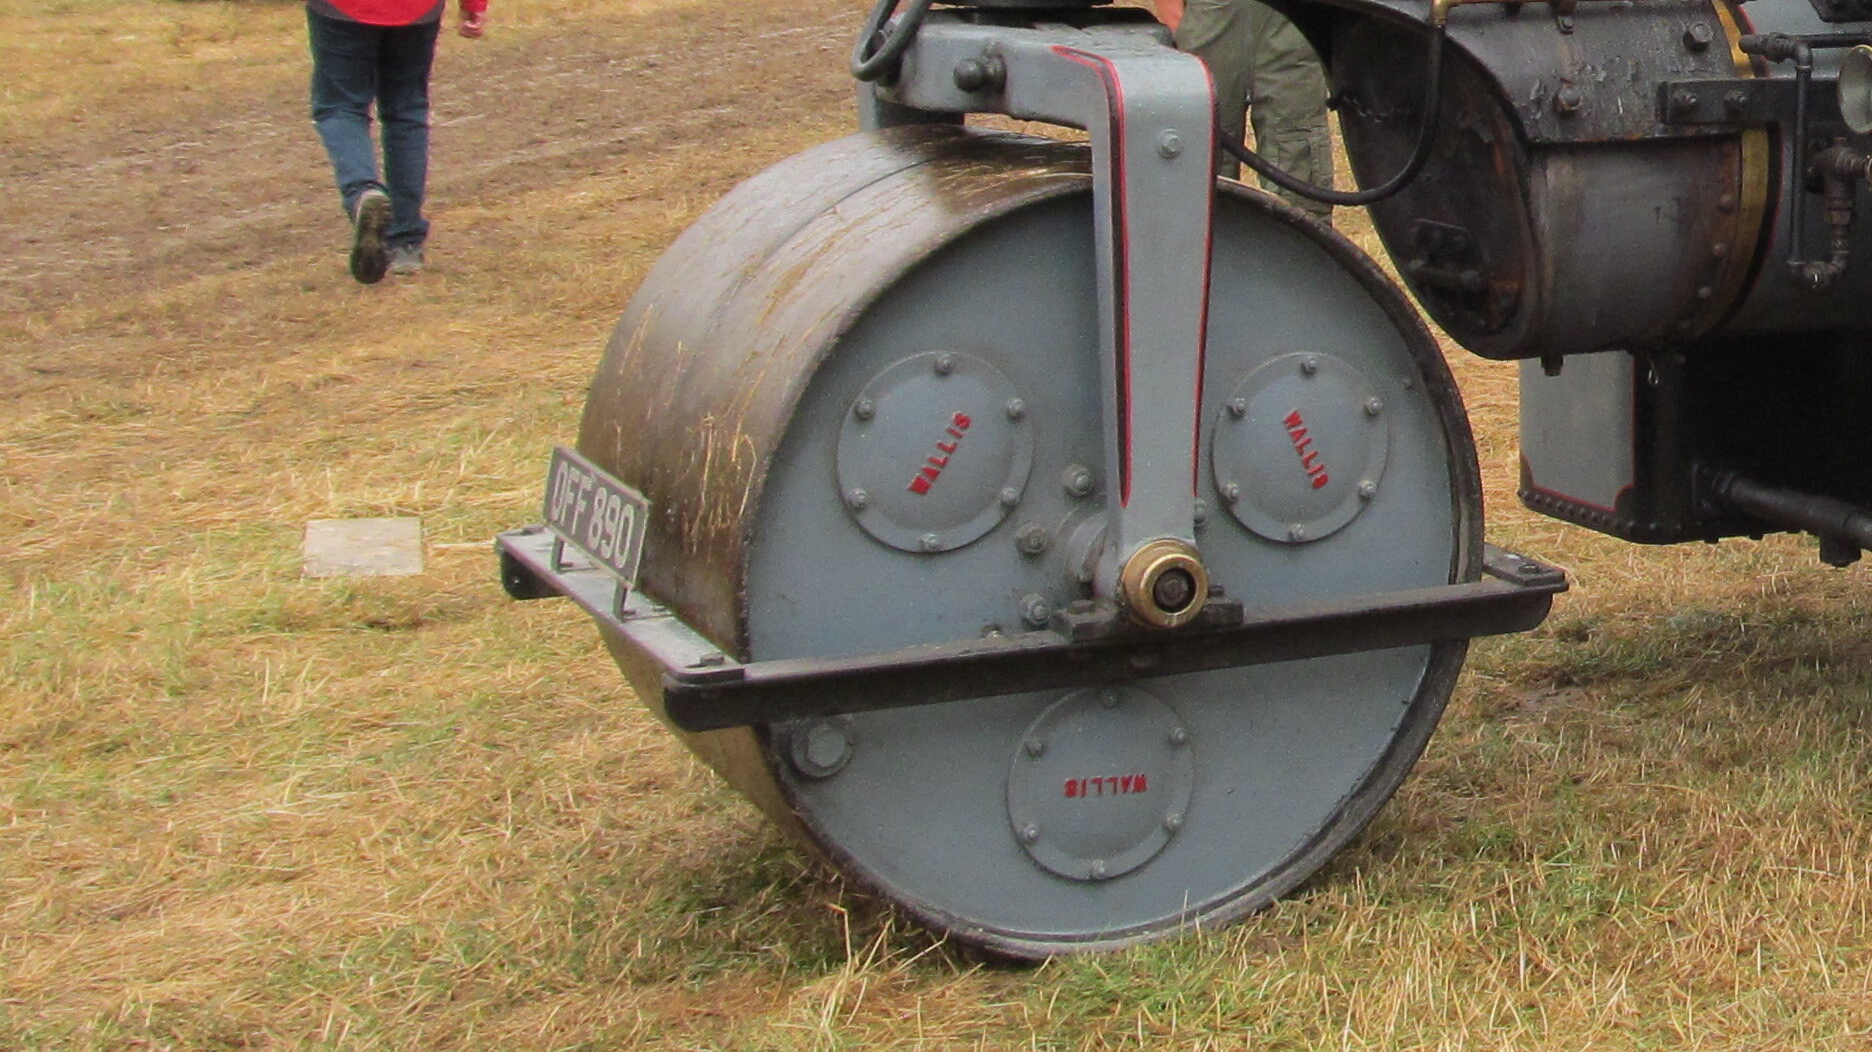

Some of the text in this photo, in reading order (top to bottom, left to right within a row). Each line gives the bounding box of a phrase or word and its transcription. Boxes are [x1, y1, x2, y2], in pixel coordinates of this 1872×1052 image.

[907, 411, 971, 495] WALLIS
[1283, 410, 1329, 489] WALLIS
[587, 486, 635, 569] 890
[1064, 774, 1148, 798] WALLIS
